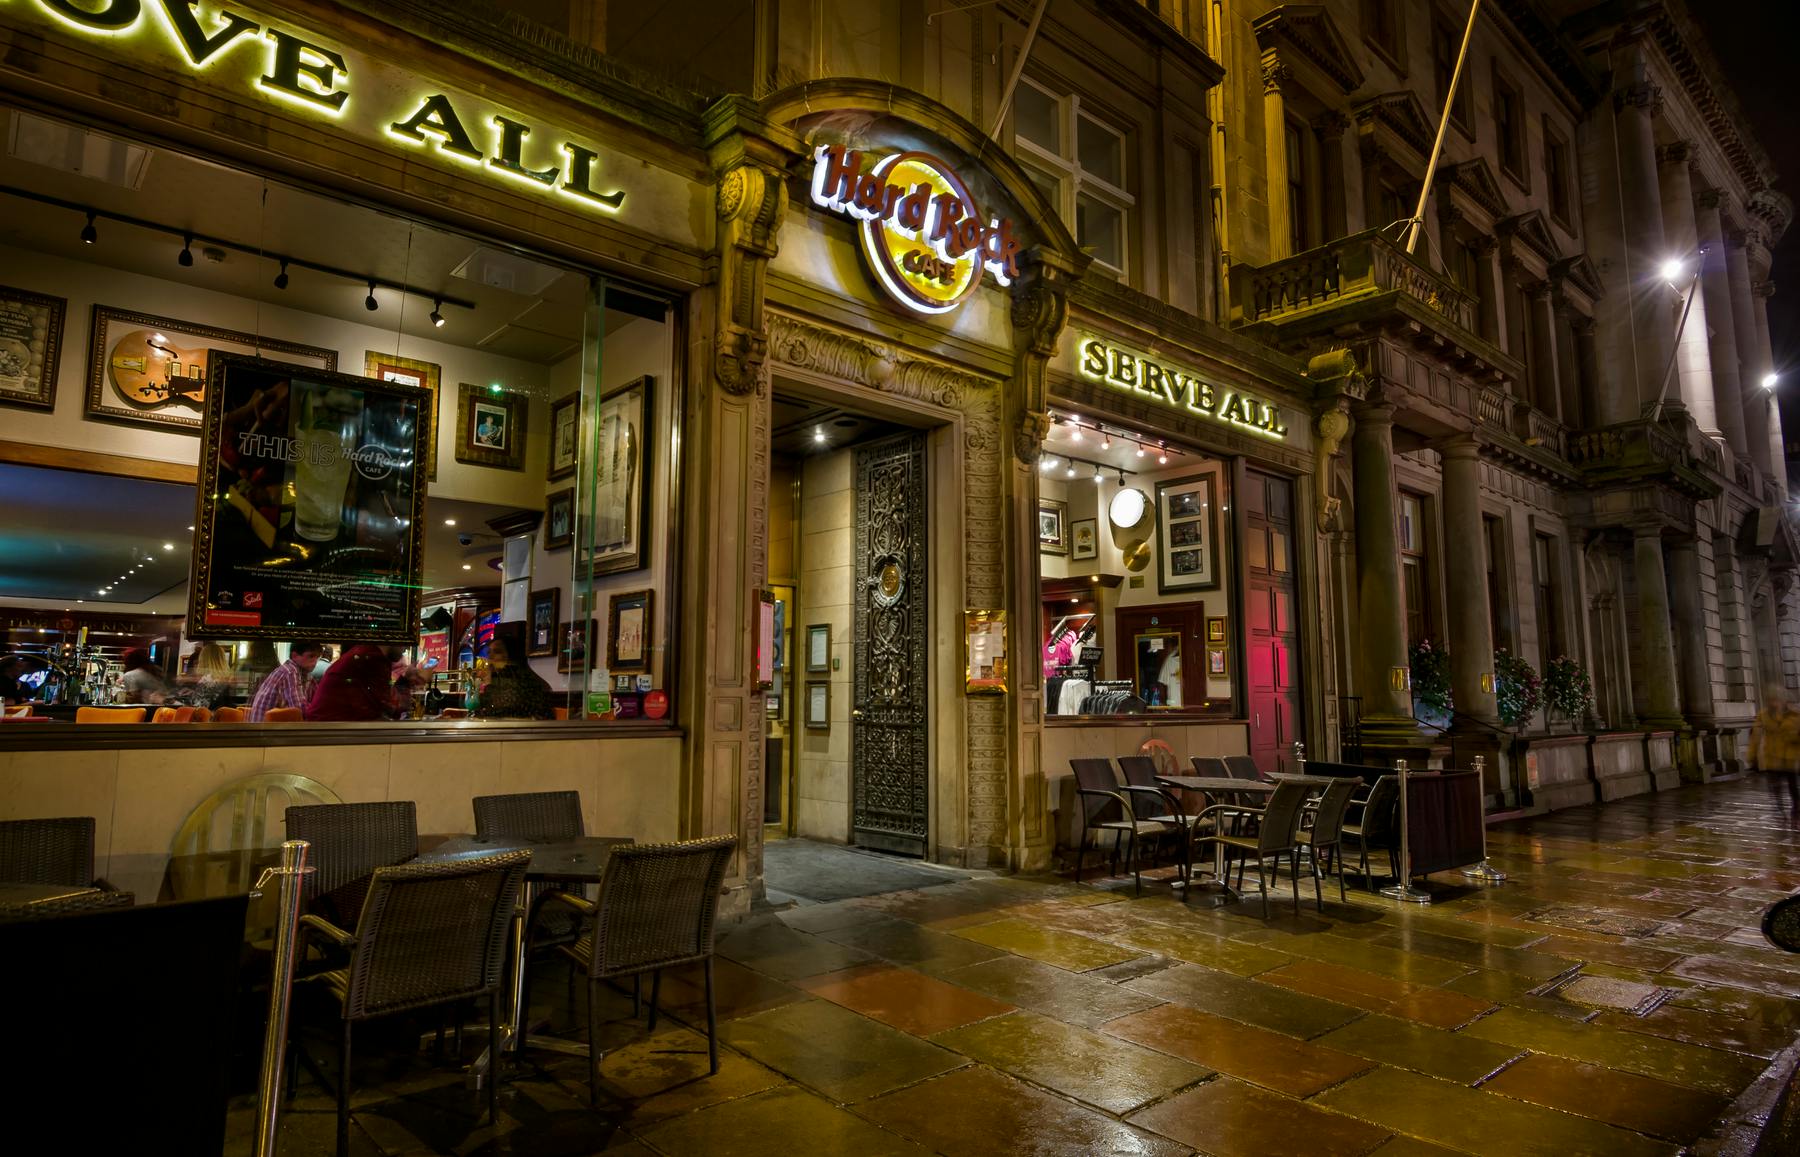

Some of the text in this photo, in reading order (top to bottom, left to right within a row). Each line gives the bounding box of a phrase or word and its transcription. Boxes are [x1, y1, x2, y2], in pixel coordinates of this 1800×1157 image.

[389, 94, 626, 211] ALL
[814, 143, 1022, 278] Hard Rock
[902, 249, 956, 285] CAFE
[1082, 340, 1288, 439] SERVE ALL
[239, 432, 336, 466] THIS IS
[341, 447, 374, 464] Hard
[365, 466, 382, 474] CAFE
